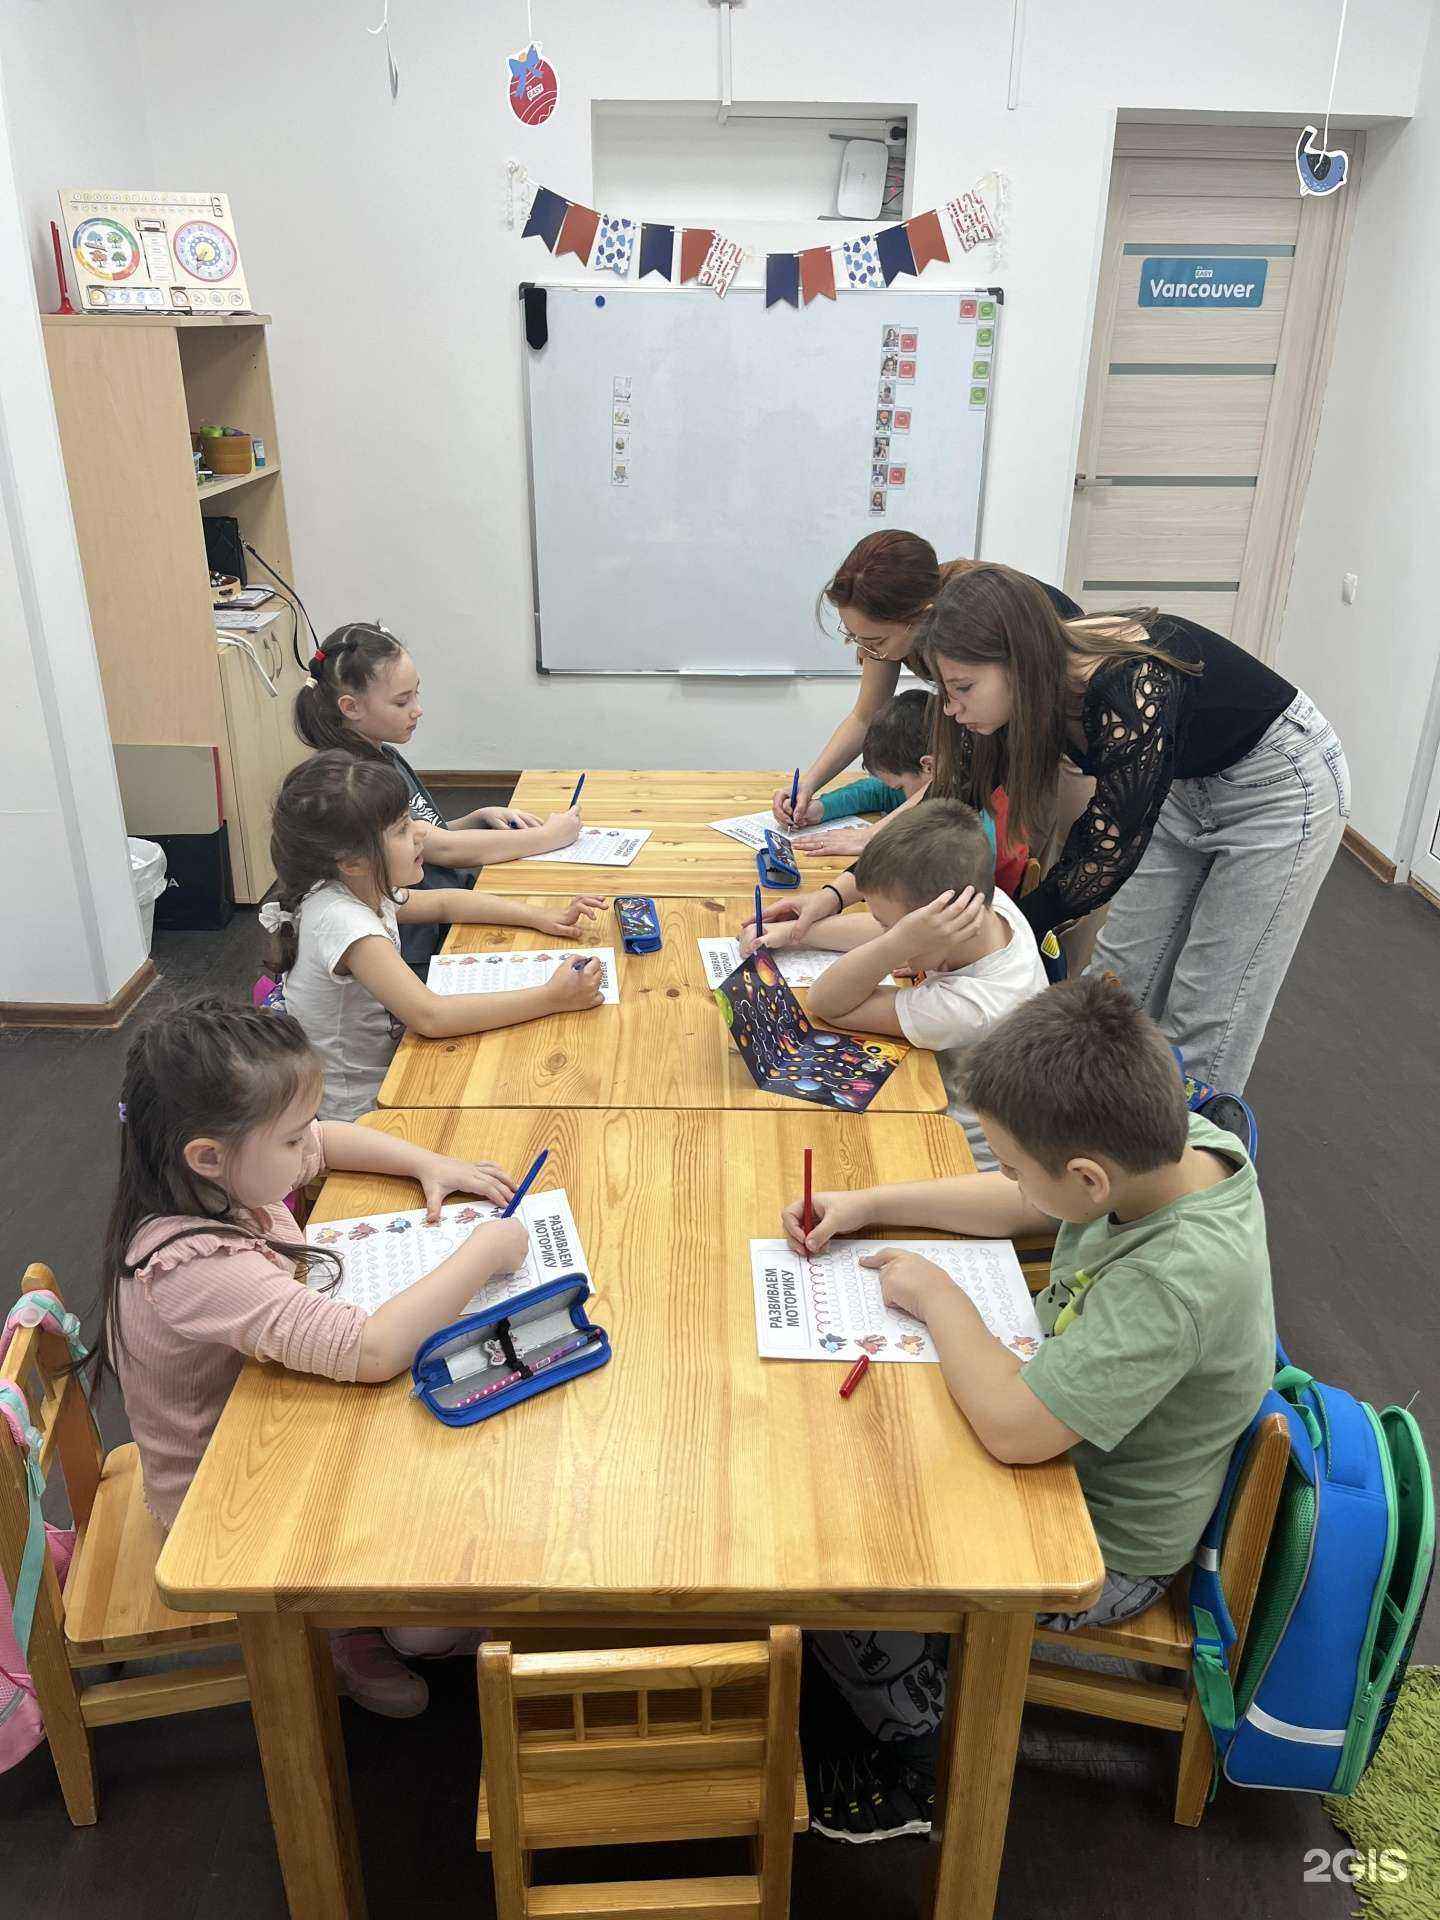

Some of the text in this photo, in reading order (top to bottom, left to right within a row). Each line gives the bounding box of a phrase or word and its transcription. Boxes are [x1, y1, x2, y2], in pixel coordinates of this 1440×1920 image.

[1150, 279, 1255, 298] Vancouver
[533, 1218, 558, 1268] МОТОРИКУ
[548, 1214, 574, 1268] РАЗВИВАЕМ
[765, 1268, 783, 1329] РАЗВИВАЕМ
[781, 1269, 800, 1327] МОТОРИКУ
